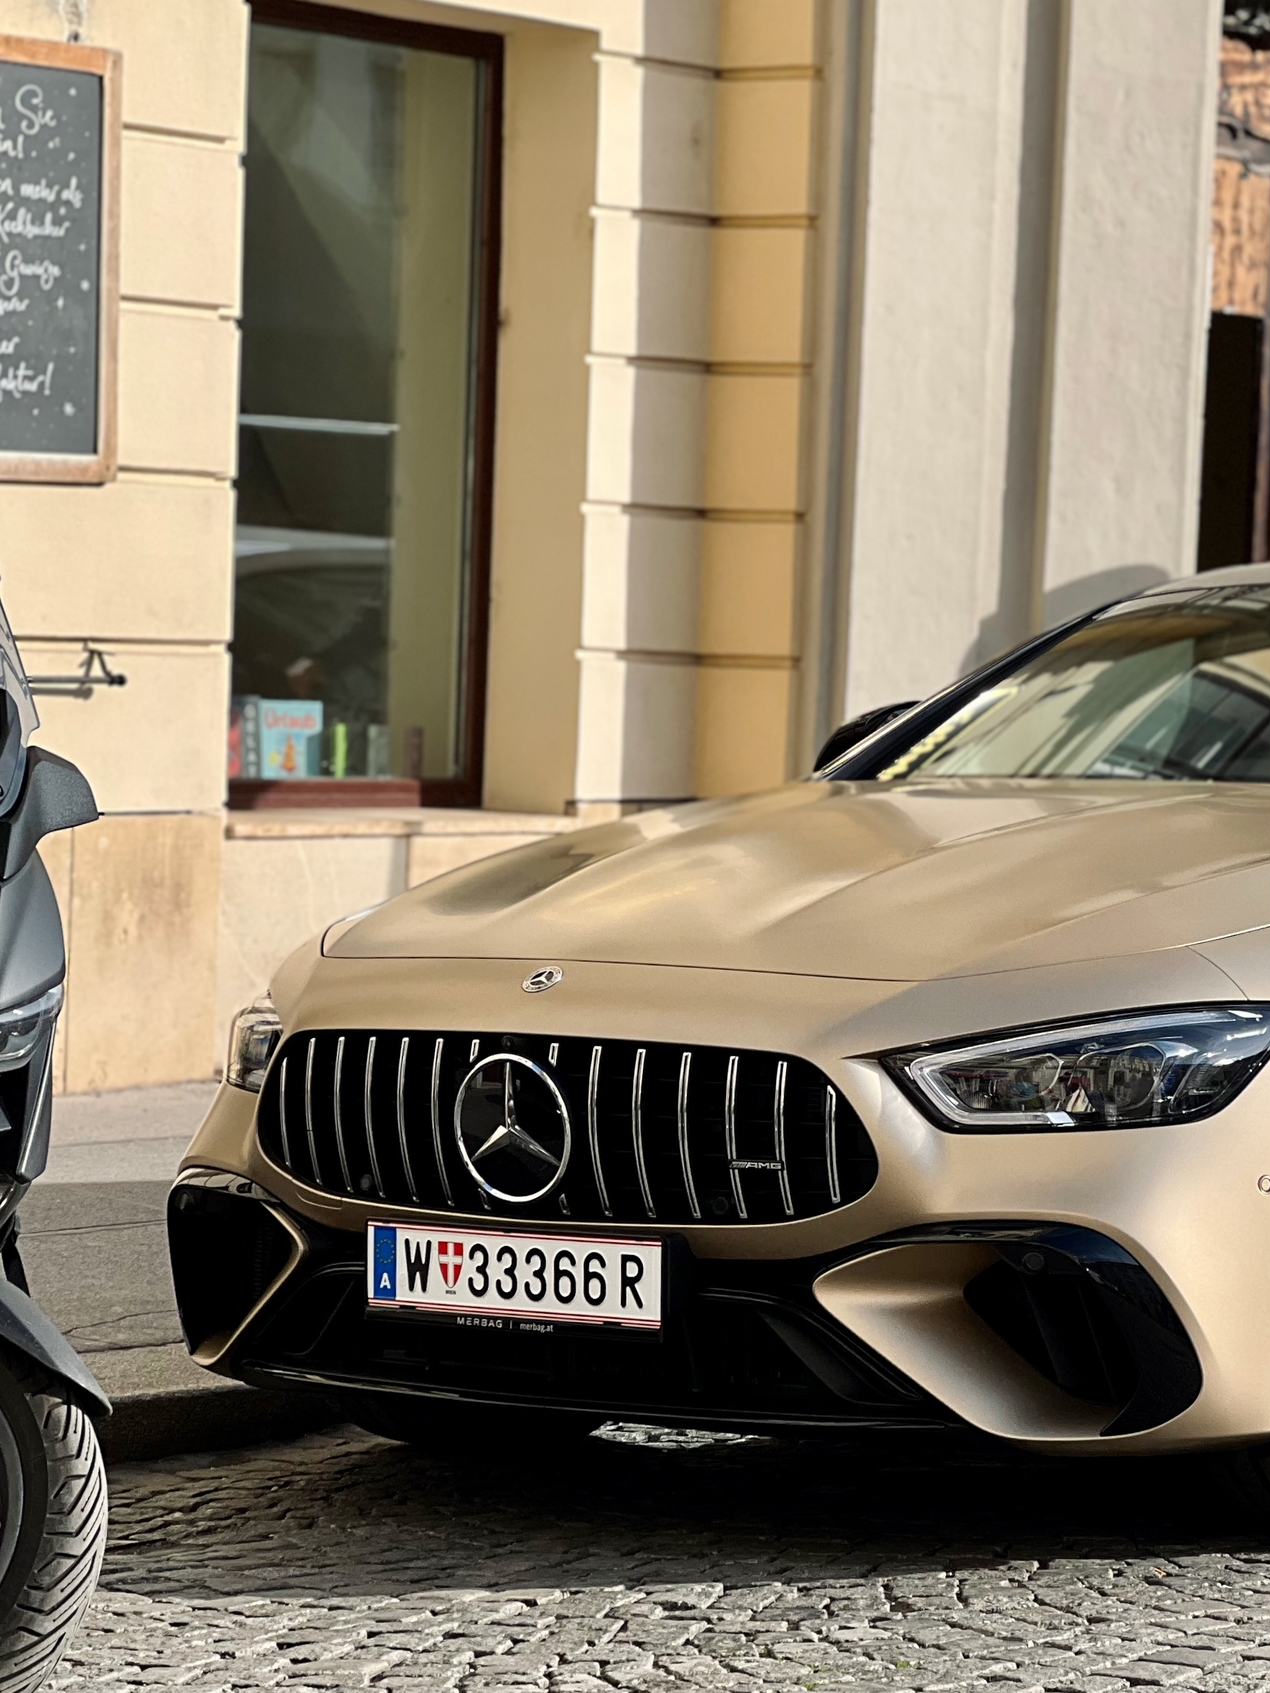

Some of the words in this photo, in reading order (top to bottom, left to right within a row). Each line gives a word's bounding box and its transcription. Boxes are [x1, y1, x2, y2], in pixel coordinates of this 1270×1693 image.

[14, 84, 57, 135] Sie
[745, 1161, 782, 1169] AMG
[379, 1272, 391, 1290] A
[457, 1316, 503, 1329] MERBAG
[519, 1321, 554, 1333] merbag.at
